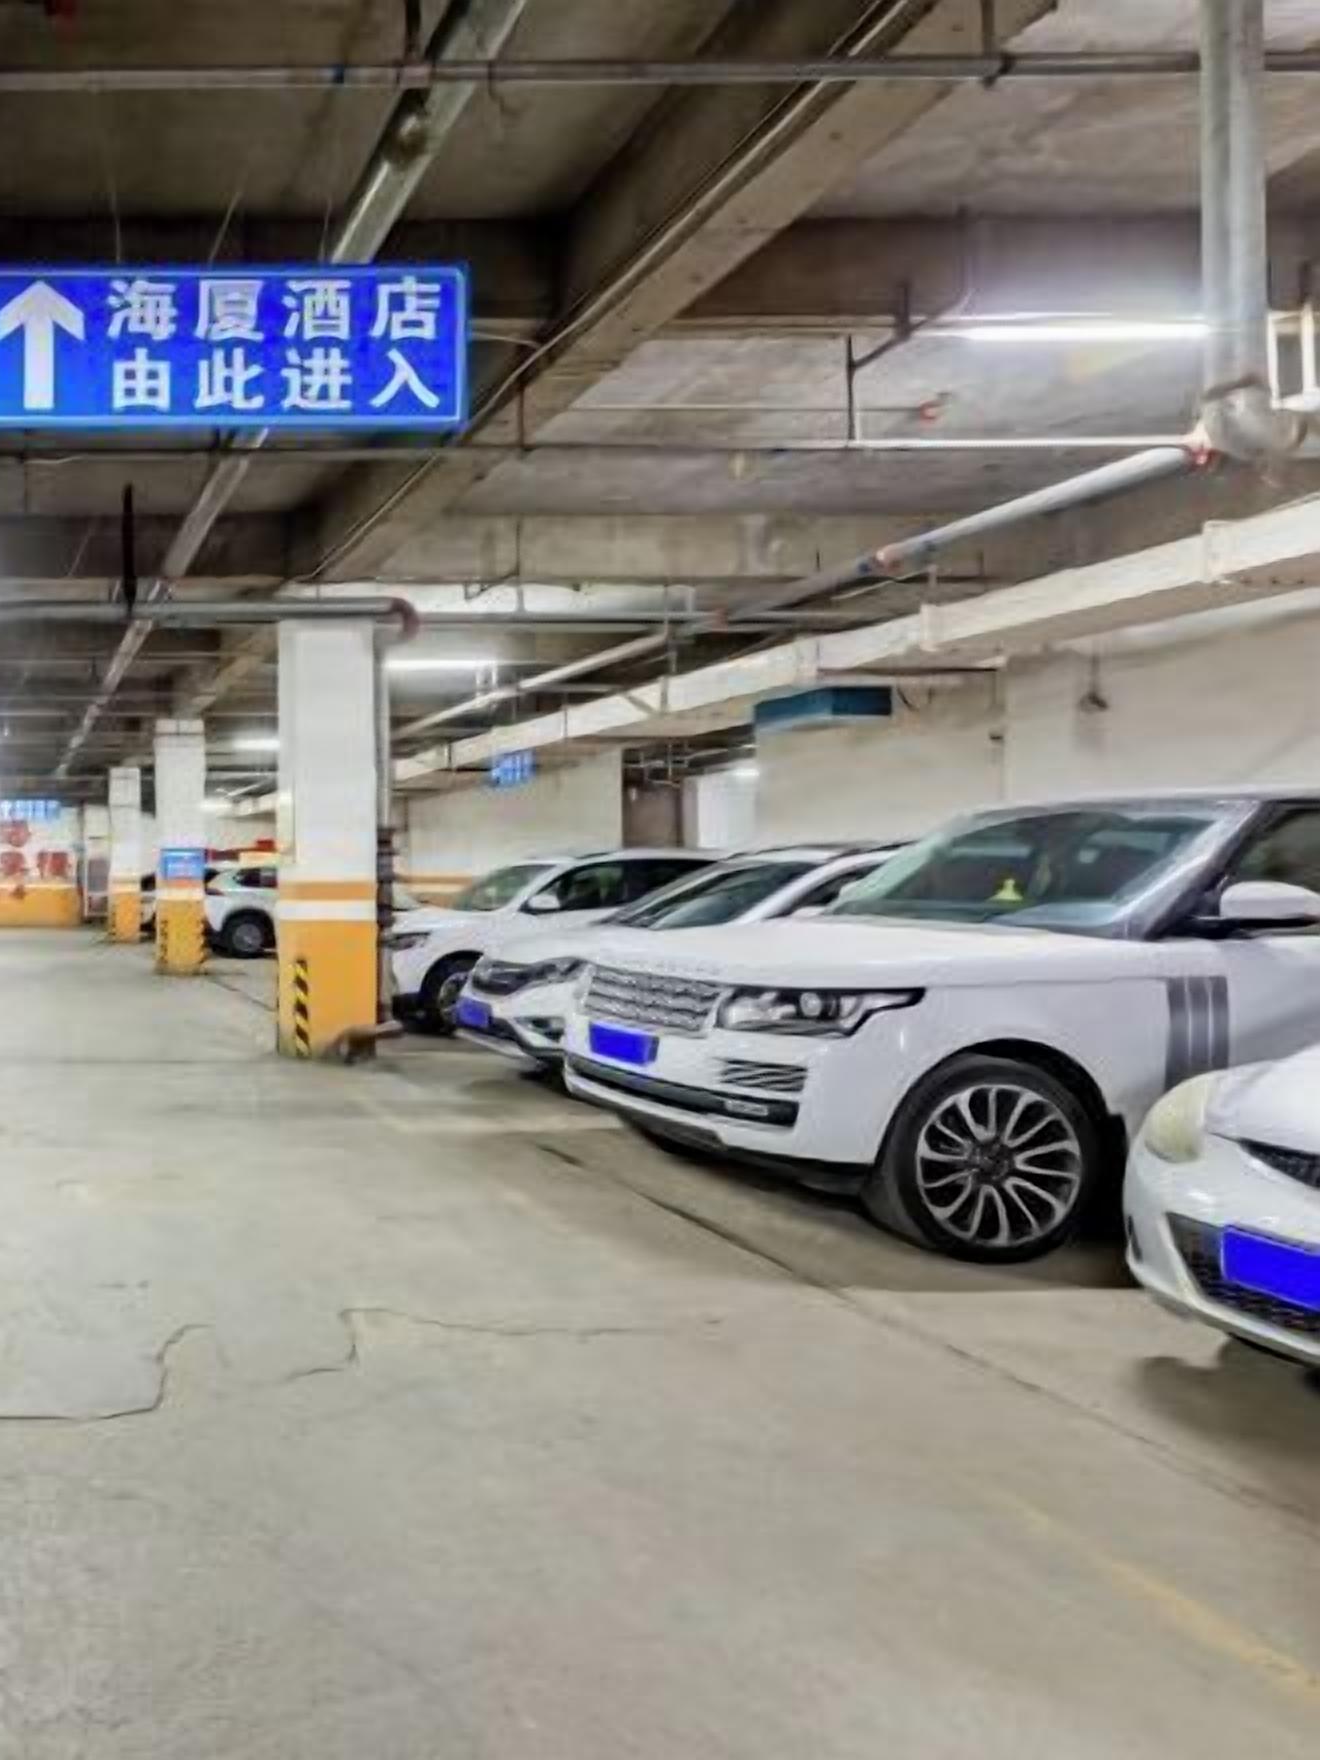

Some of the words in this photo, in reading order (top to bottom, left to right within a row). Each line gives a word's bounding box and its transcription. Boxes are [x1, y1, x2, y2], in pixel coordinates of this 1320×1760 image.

[108, 278, 441, 340] 海厦酒店
[113, 348, 440, 409] 由此进入
